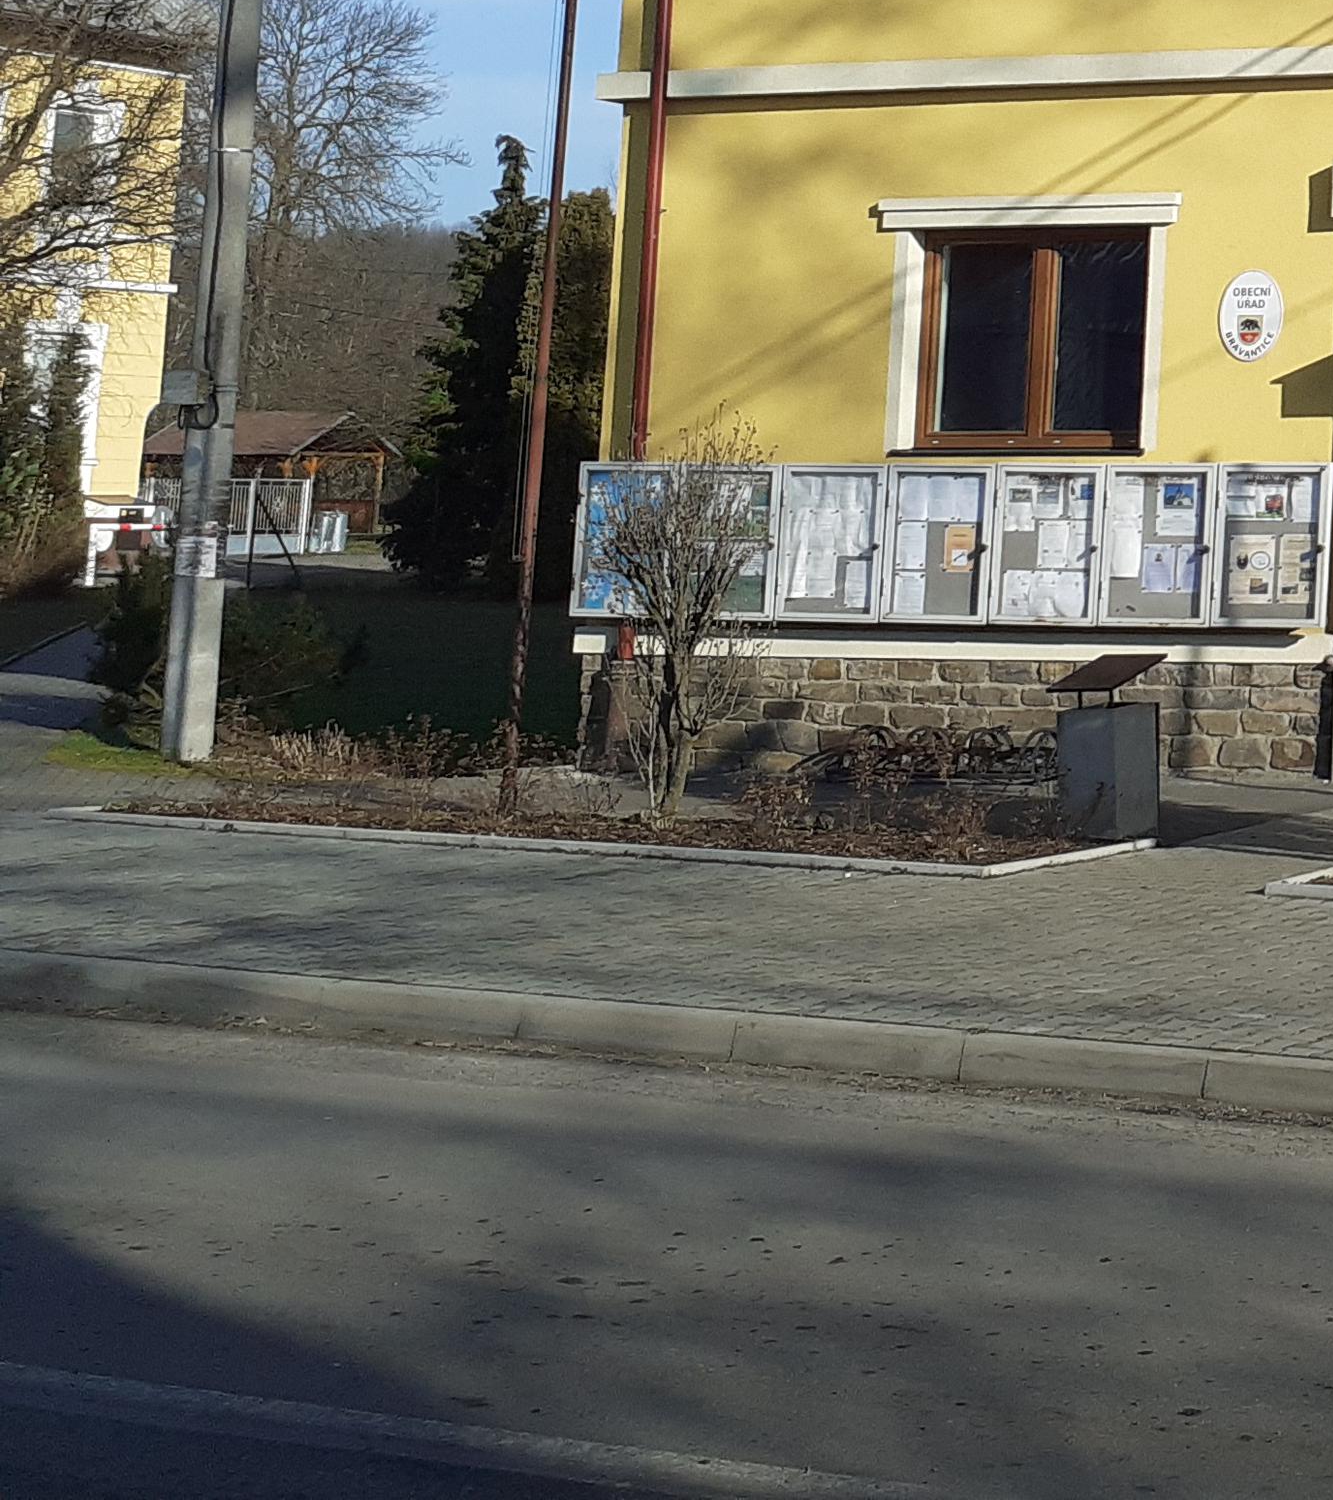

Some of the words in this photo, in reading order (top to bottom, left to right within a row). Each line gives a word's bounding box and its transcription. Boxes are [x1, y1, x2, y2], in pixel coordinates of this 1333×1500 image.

[1233, 285, 1271, 296] OBECNÍ
[1237, 297, 1266, 308] ÚŘAD
[1225, 331, 1275, 359] BRAVANTICE
